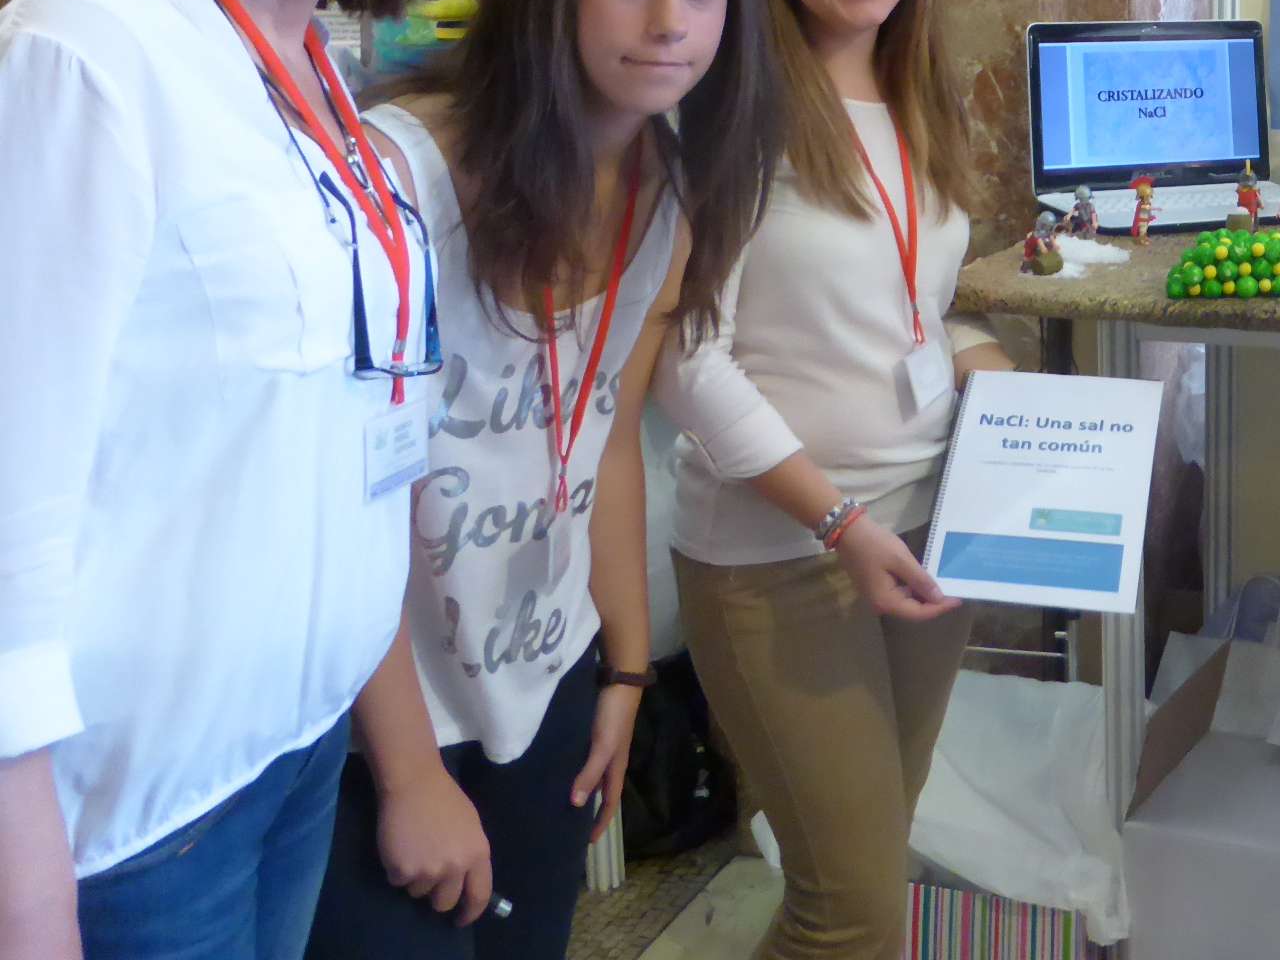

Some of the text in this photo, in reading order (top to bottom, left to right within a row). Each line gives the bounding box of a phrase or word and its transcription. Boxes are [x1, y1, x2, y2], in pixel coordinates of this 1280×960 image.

[1097, 87, 1204, 103] CRISTALIZANDO
[1138, 106, 1167, 119] NaCl
[979, 413, 1134, 433] NaCl: Una sal no
[1001, 437, 1103, 454] tan común
